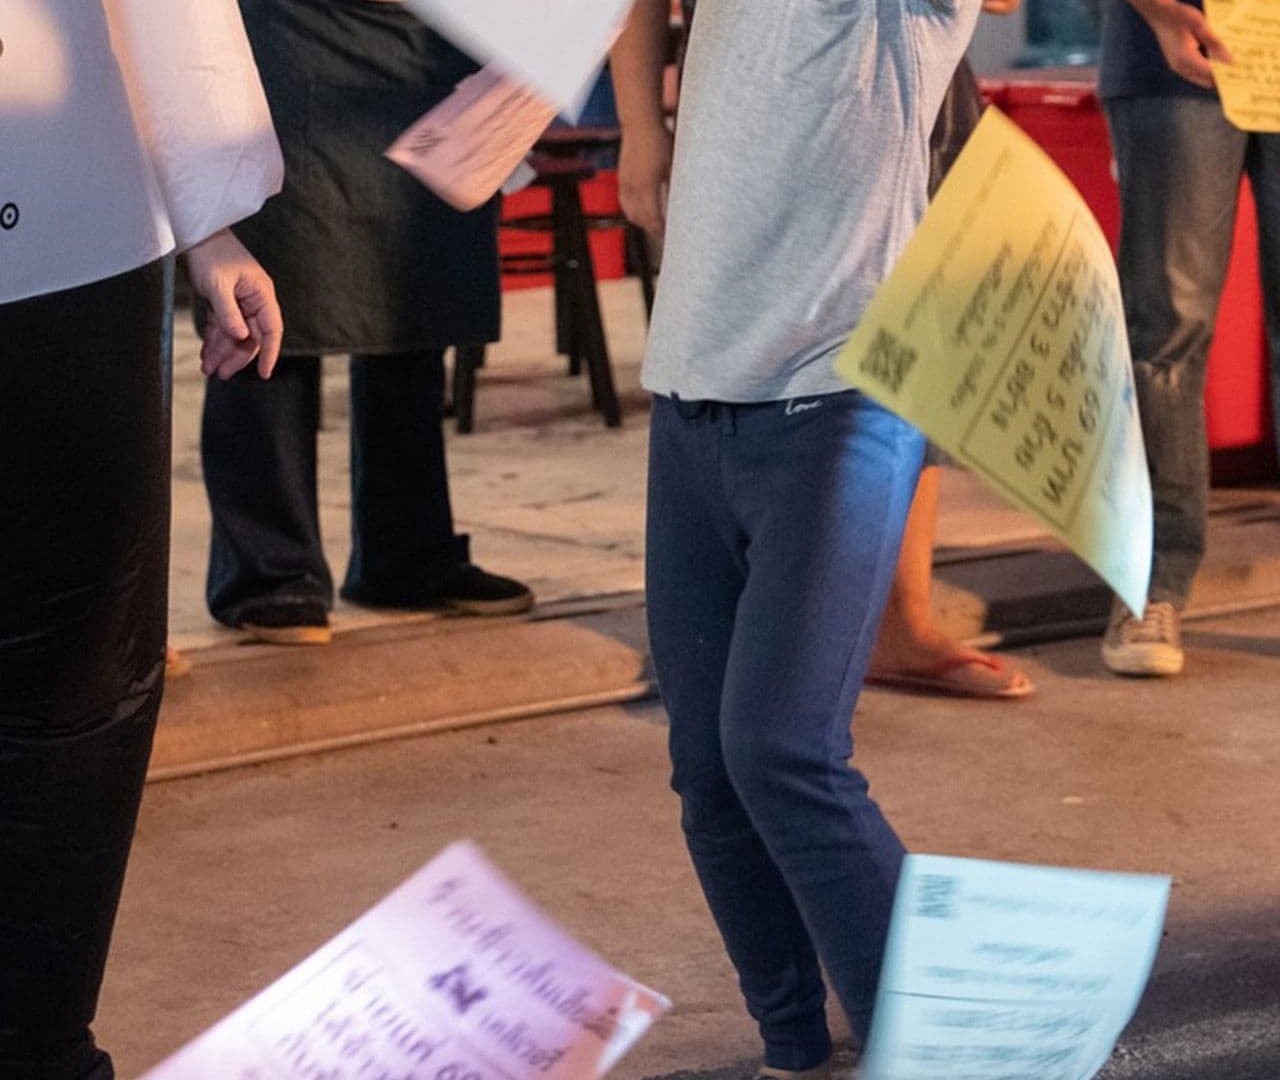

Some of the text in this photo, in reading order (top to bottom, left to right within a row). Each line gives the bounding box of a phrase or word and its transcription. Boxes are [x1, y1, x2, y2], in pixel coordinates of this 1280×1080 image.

[1026, 335, 1055, 362] 3
[1041, 384, 1072, 413] 5
[1070, 386, 1111, 436] 69
[1038, 439, 1088, 508] บาท
